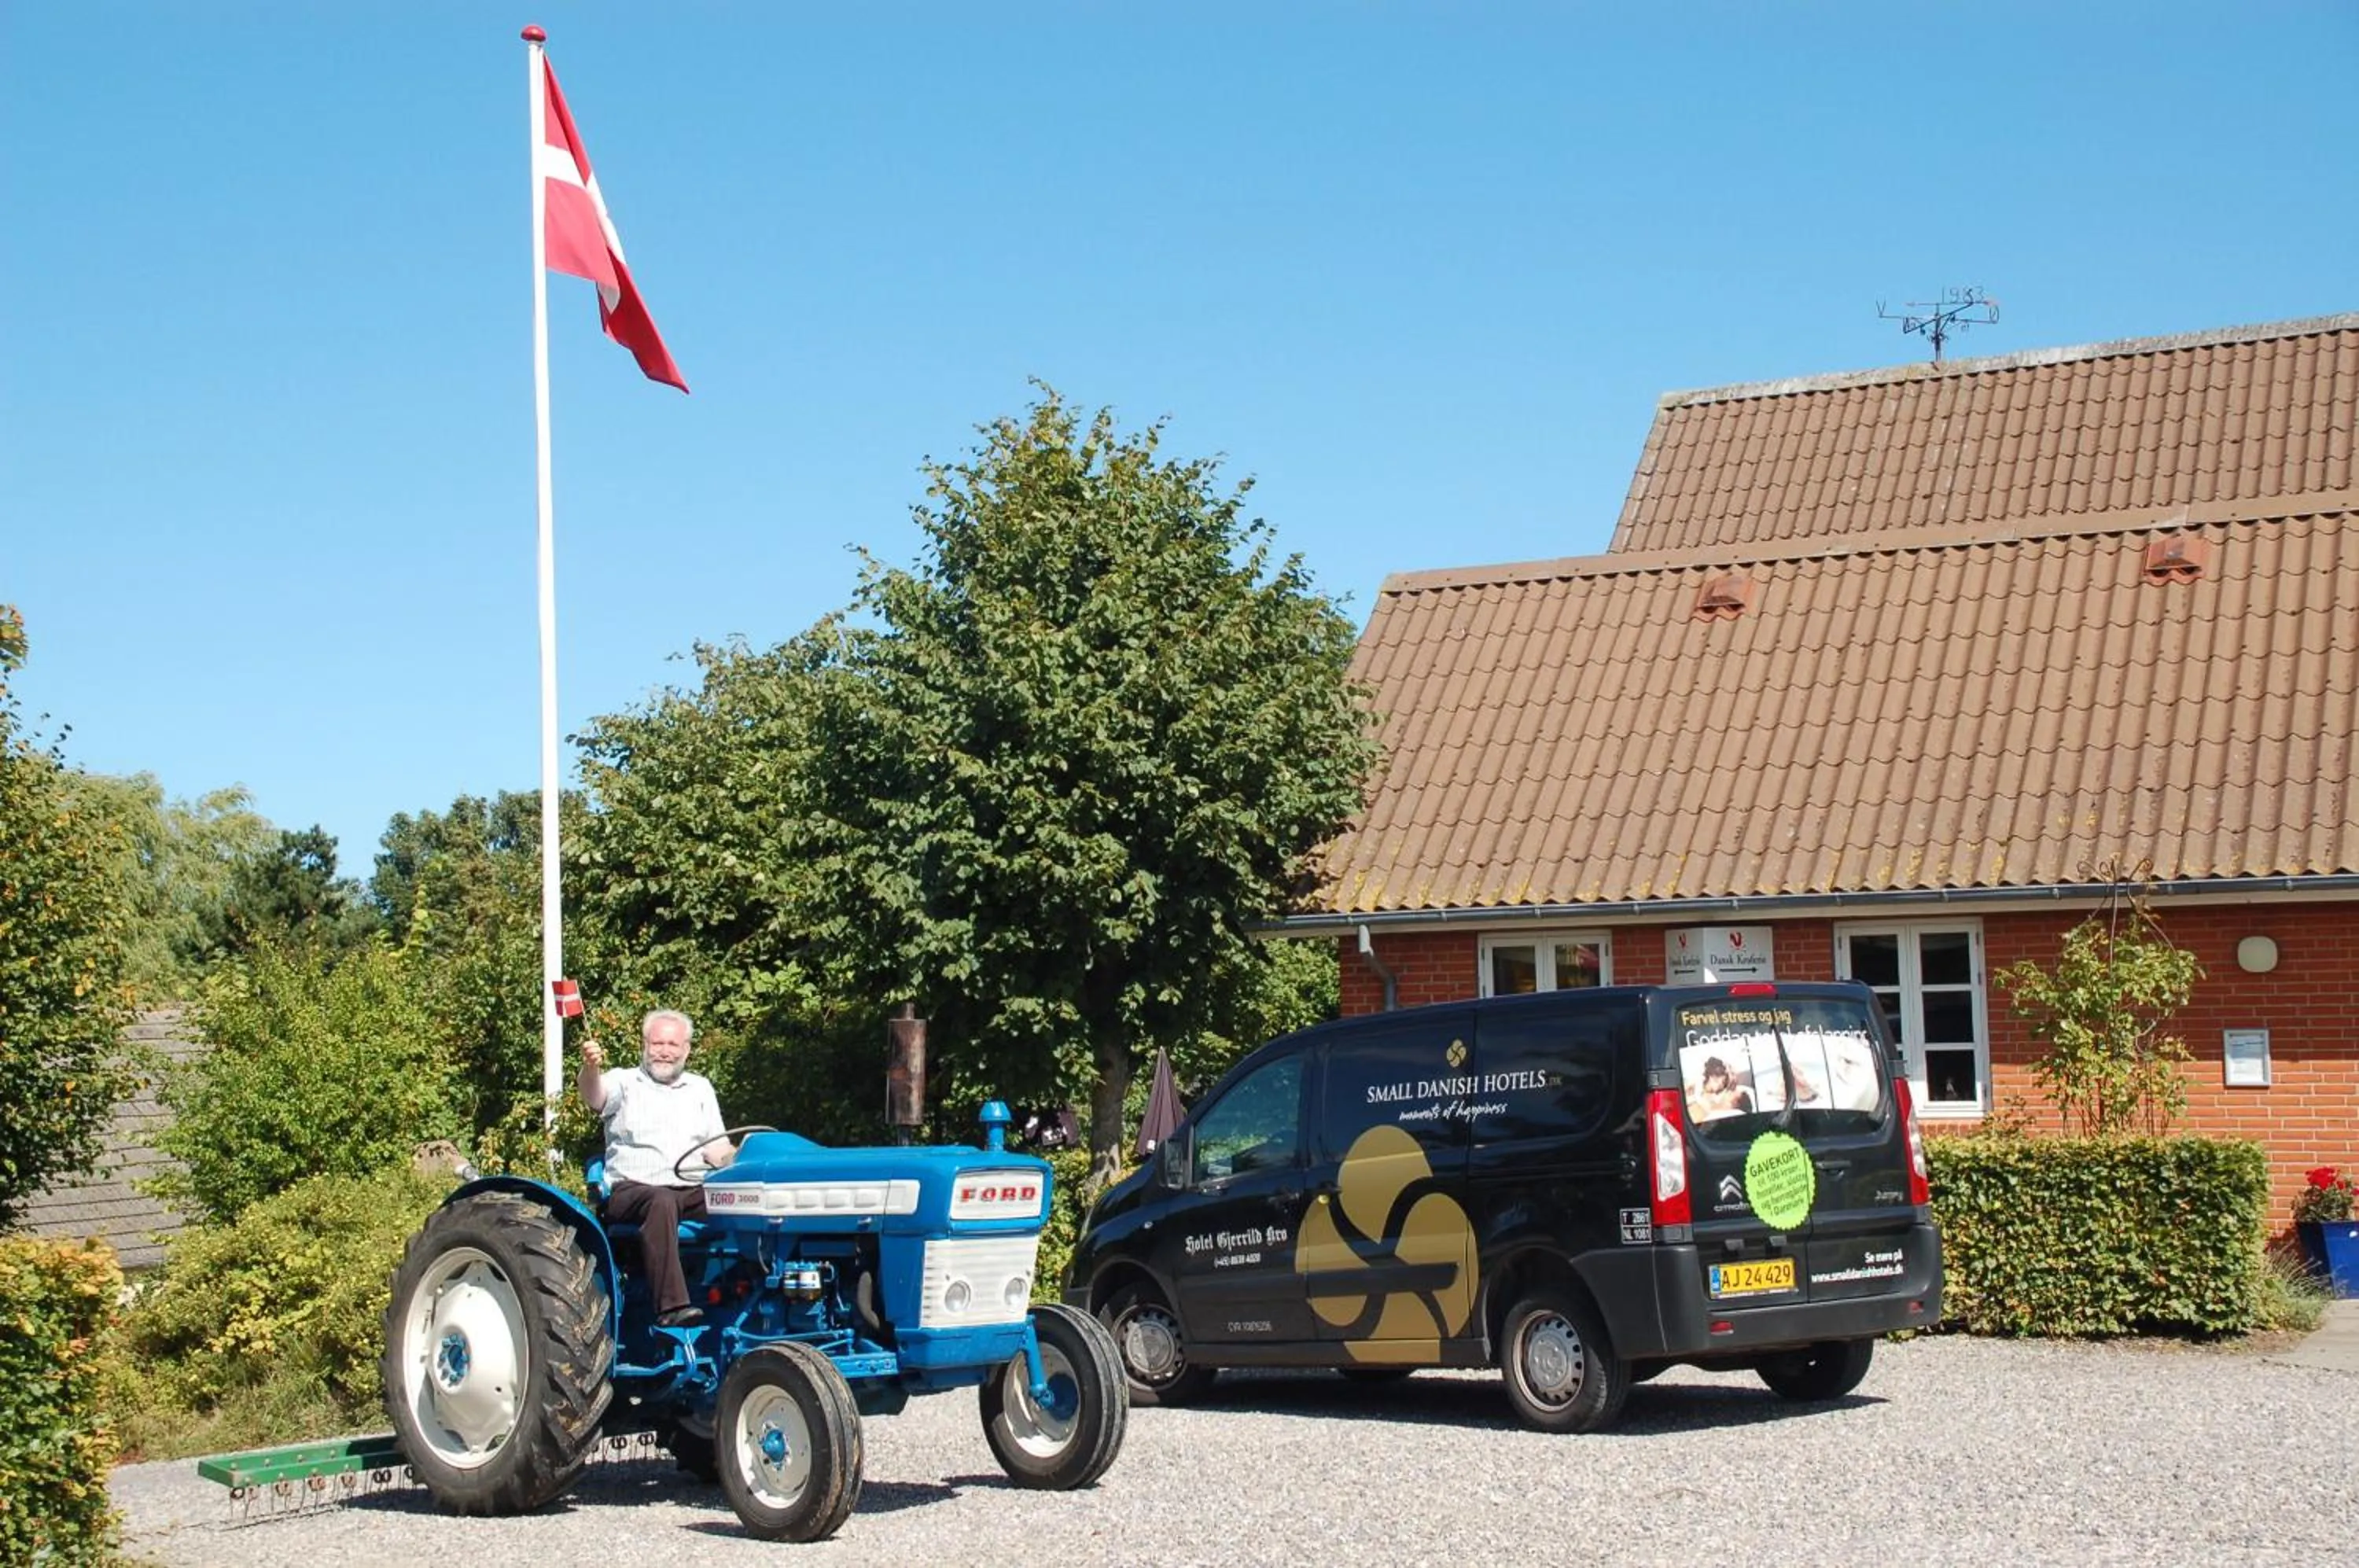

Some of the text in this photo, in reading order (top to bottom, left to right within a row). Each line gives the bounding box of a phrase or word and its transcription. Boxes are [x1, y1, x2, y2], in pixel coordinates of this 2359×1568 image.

[1681, 1009, 1720, 1026] Farvel
[1721, 1010, 1757, 1024] stress
[1757, 1010, 1772, 1025] og
[1367, 1081, 1413, 1102] SMALL
[1417, 1076, 1479, 1099] DANISH
[1484, 1069, 1546, 1093] HOTELS
[1399, 1100, 1508, 1123] moments of happiness
[1749, 1147, 1800, 1177] GAVEKORT
[710, 1192, 760, 1206] FORD 3000
[960, 1186, 1036, 1203] FORD
[1184, 1233, 1213, 1256] Hotel
[1266, 1224, 1287, 1246] Kro
[1721, 1264, 1790, 1288] AJ 24 429
